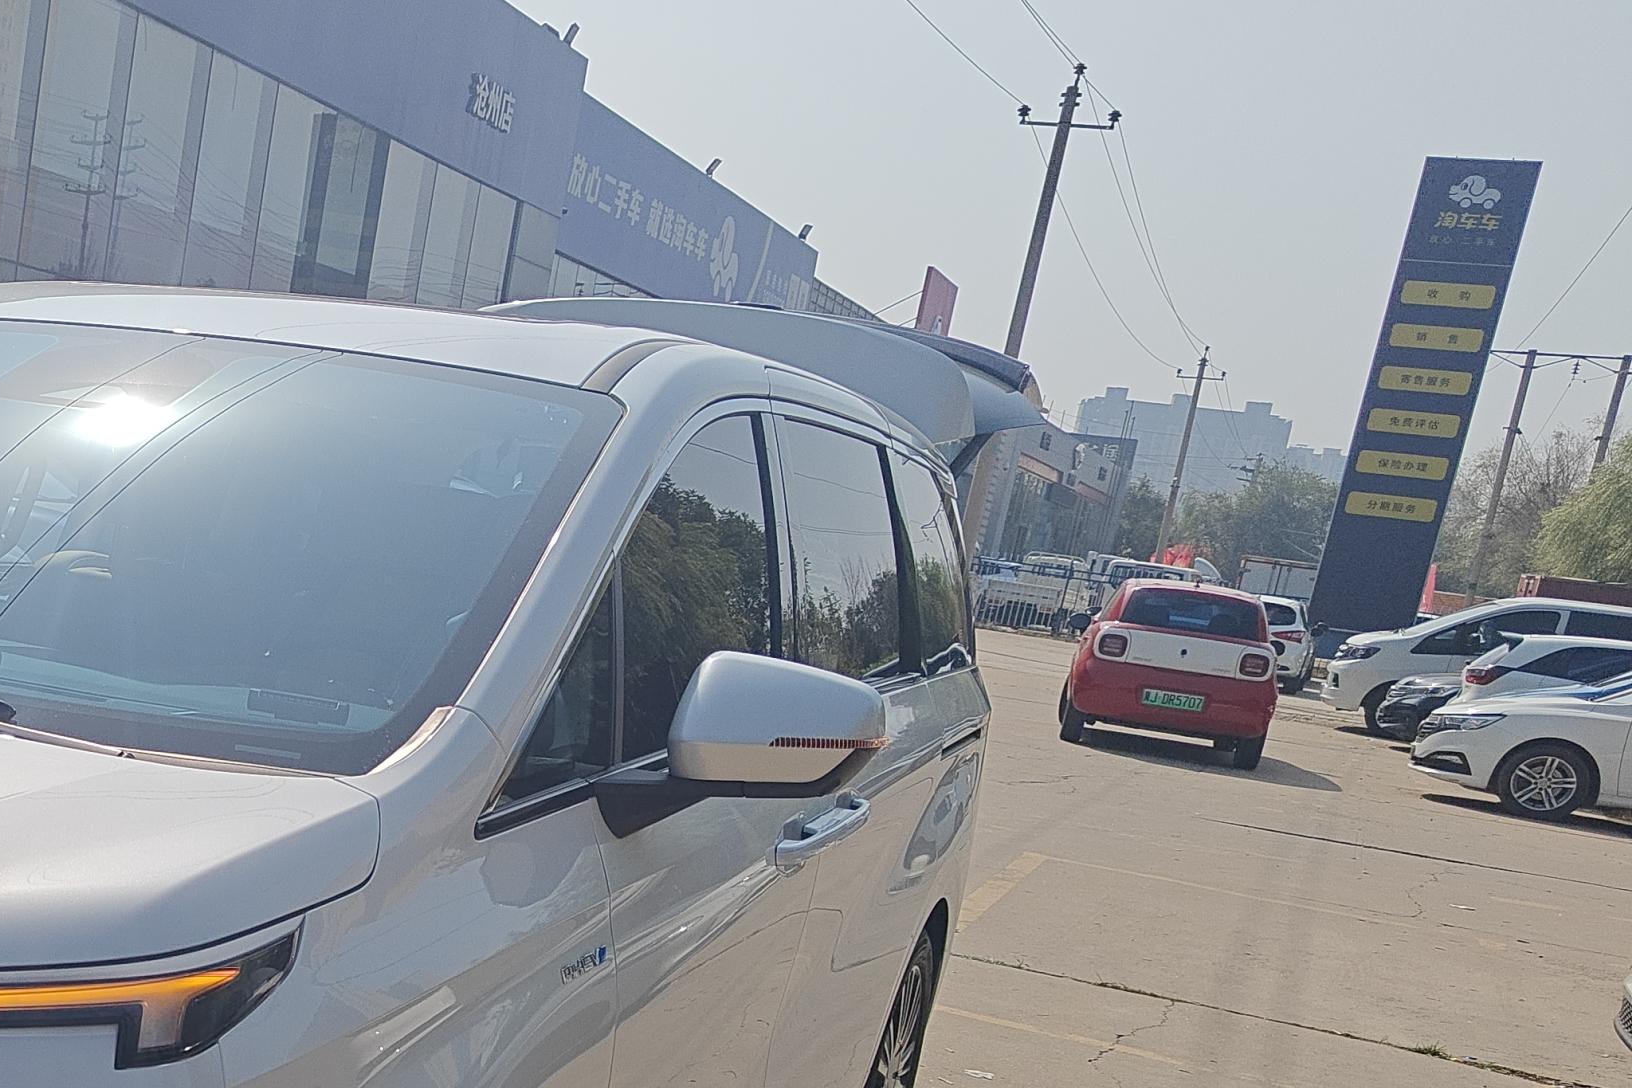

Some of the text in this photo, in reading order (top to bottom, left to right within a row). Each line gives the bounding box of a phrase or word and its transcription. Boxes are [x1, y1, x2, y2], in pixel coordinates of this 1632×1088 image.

[472, 73, 516, 134] 沧州店
[567, 152, 709, 262] 放心二手车 就选淘车车
[1433, 211, 1503, 231] 淘车车
[1400, 374, 1452, 388] 寄售服务
[1388, 416, 1441, 431] 免费评估
[1377, 458, 1429, 473] 保险办理
[1365, 500, 1417, 514] 分期服务
